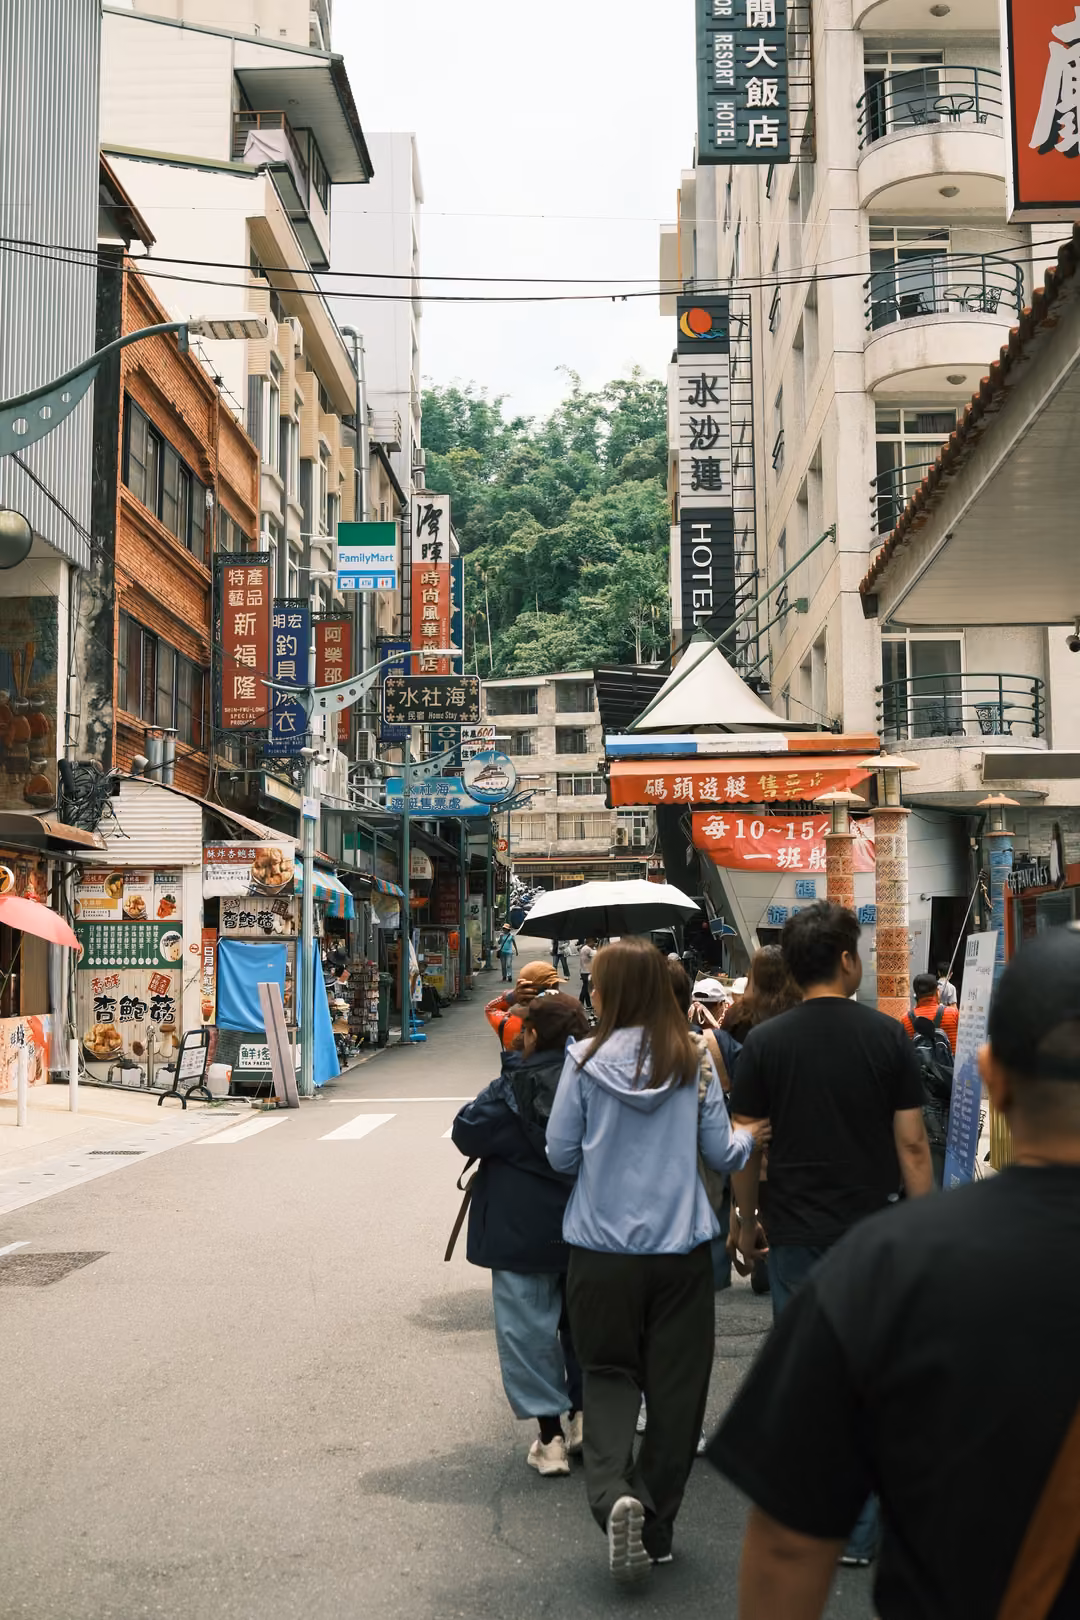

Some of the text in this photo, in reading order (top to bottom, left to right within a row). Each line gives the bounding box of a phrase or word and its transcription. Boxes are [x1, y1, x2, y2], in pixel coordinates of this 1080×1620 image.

[714, 34, 735, 86] RESORT
[716, 102, 735, 145] HOTEL
[688, 372, 722, 491] 水沙連
[338, 553, 394, 565] FamilyMart
[691, 523, 713, 627] HOTEL
[273, 613, 302, 629] 明宏
[233, 612, 257, 700] 新福隆
[398, 686, 467, 708] 水社海
[407, 711, 458, 721] 民宿 Home Stay
[477, 727, 494, 738] 600
[795, 879, 817, 899] 碼
[222, 910, 275, 929] 杏鮑菇
[203, 945, 215, 996] 日月潭紅茶
[93, 994, 177, 1024] 杏鮑菇
